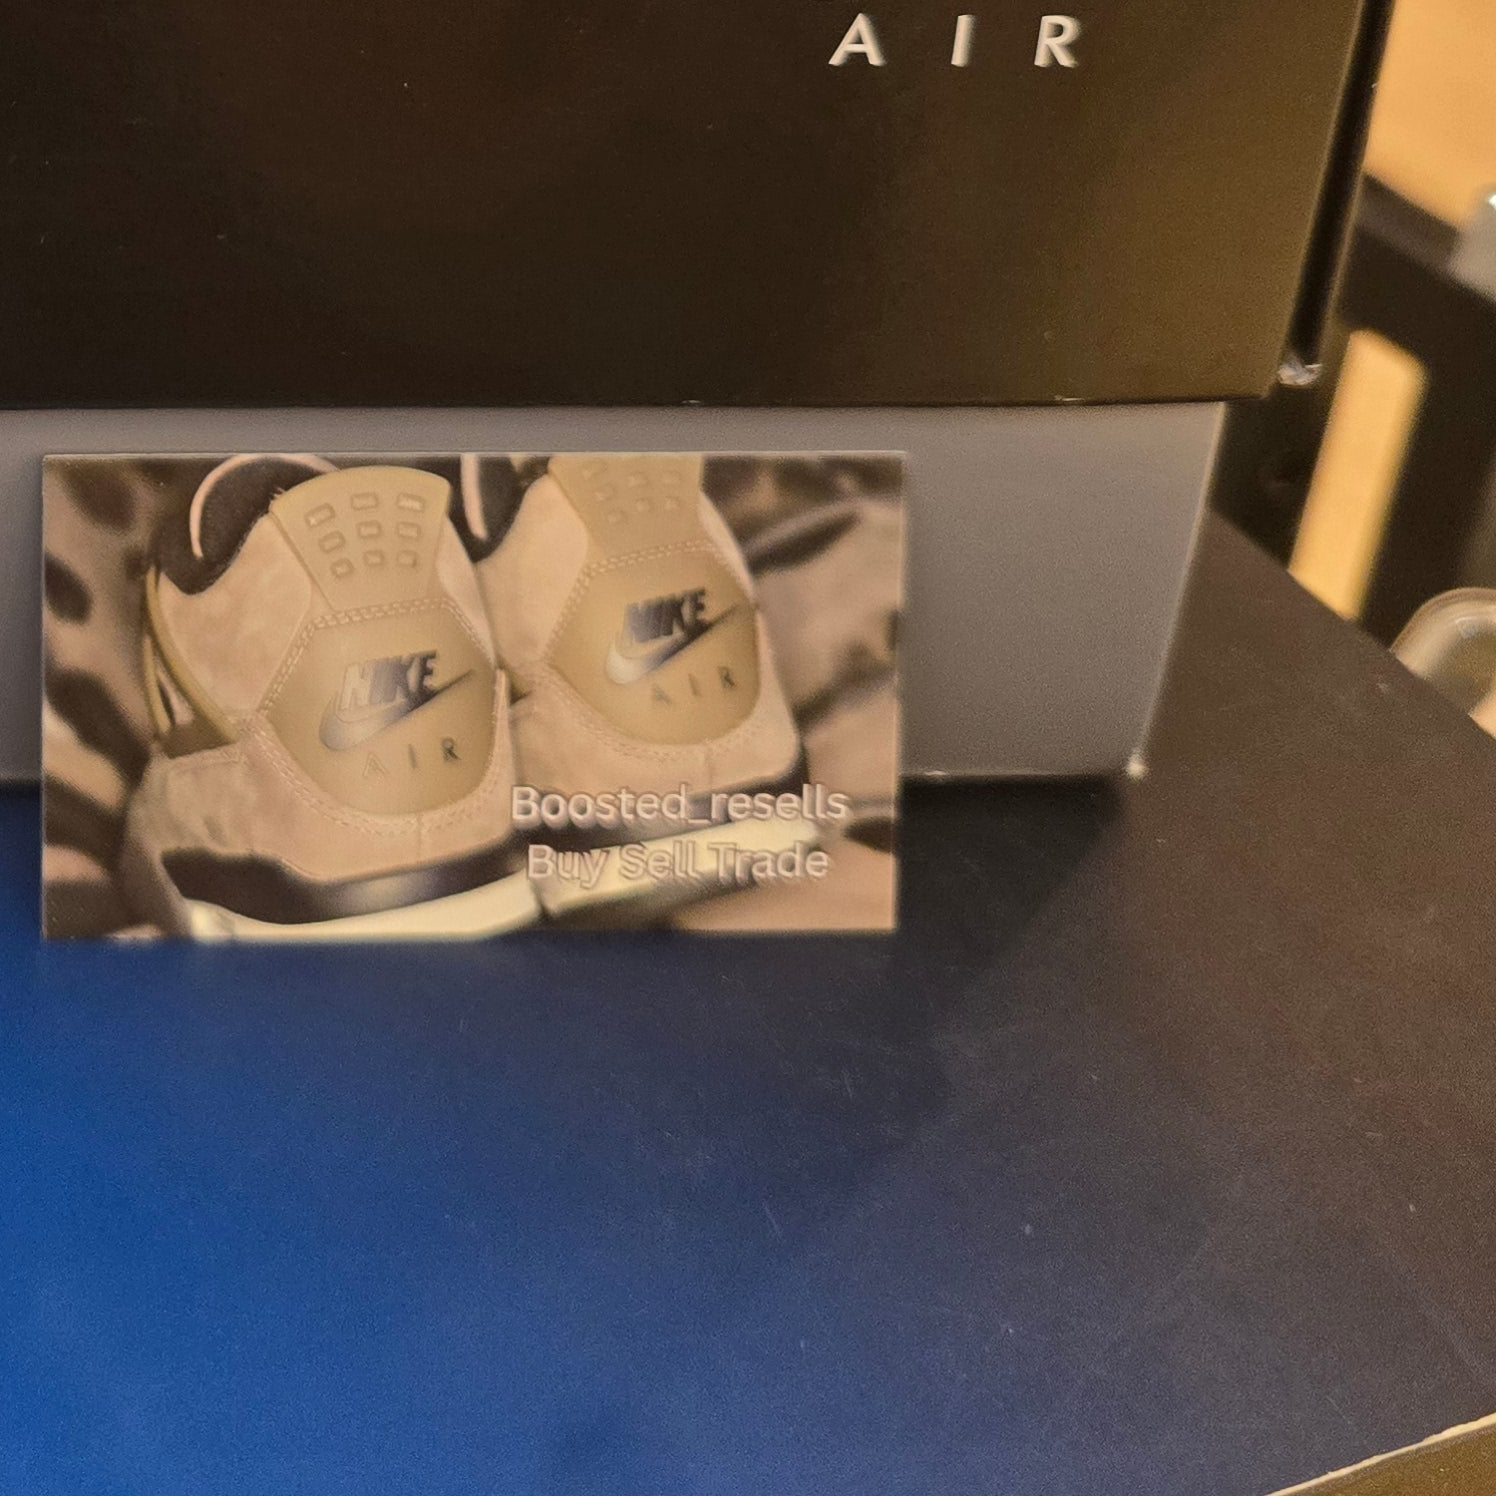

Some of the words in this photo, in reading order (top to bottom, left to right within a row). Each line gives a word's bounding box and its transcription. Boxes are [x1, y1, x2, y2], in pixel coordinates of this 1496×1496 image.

[828, 12, 1083, 68] AIR
[511, 784, 849, 824] Boosted_resells
[527, 843, 609, 888] Buy
[618, 840, 701, 878] Sell
[709, 841, 830, 880] Trade
